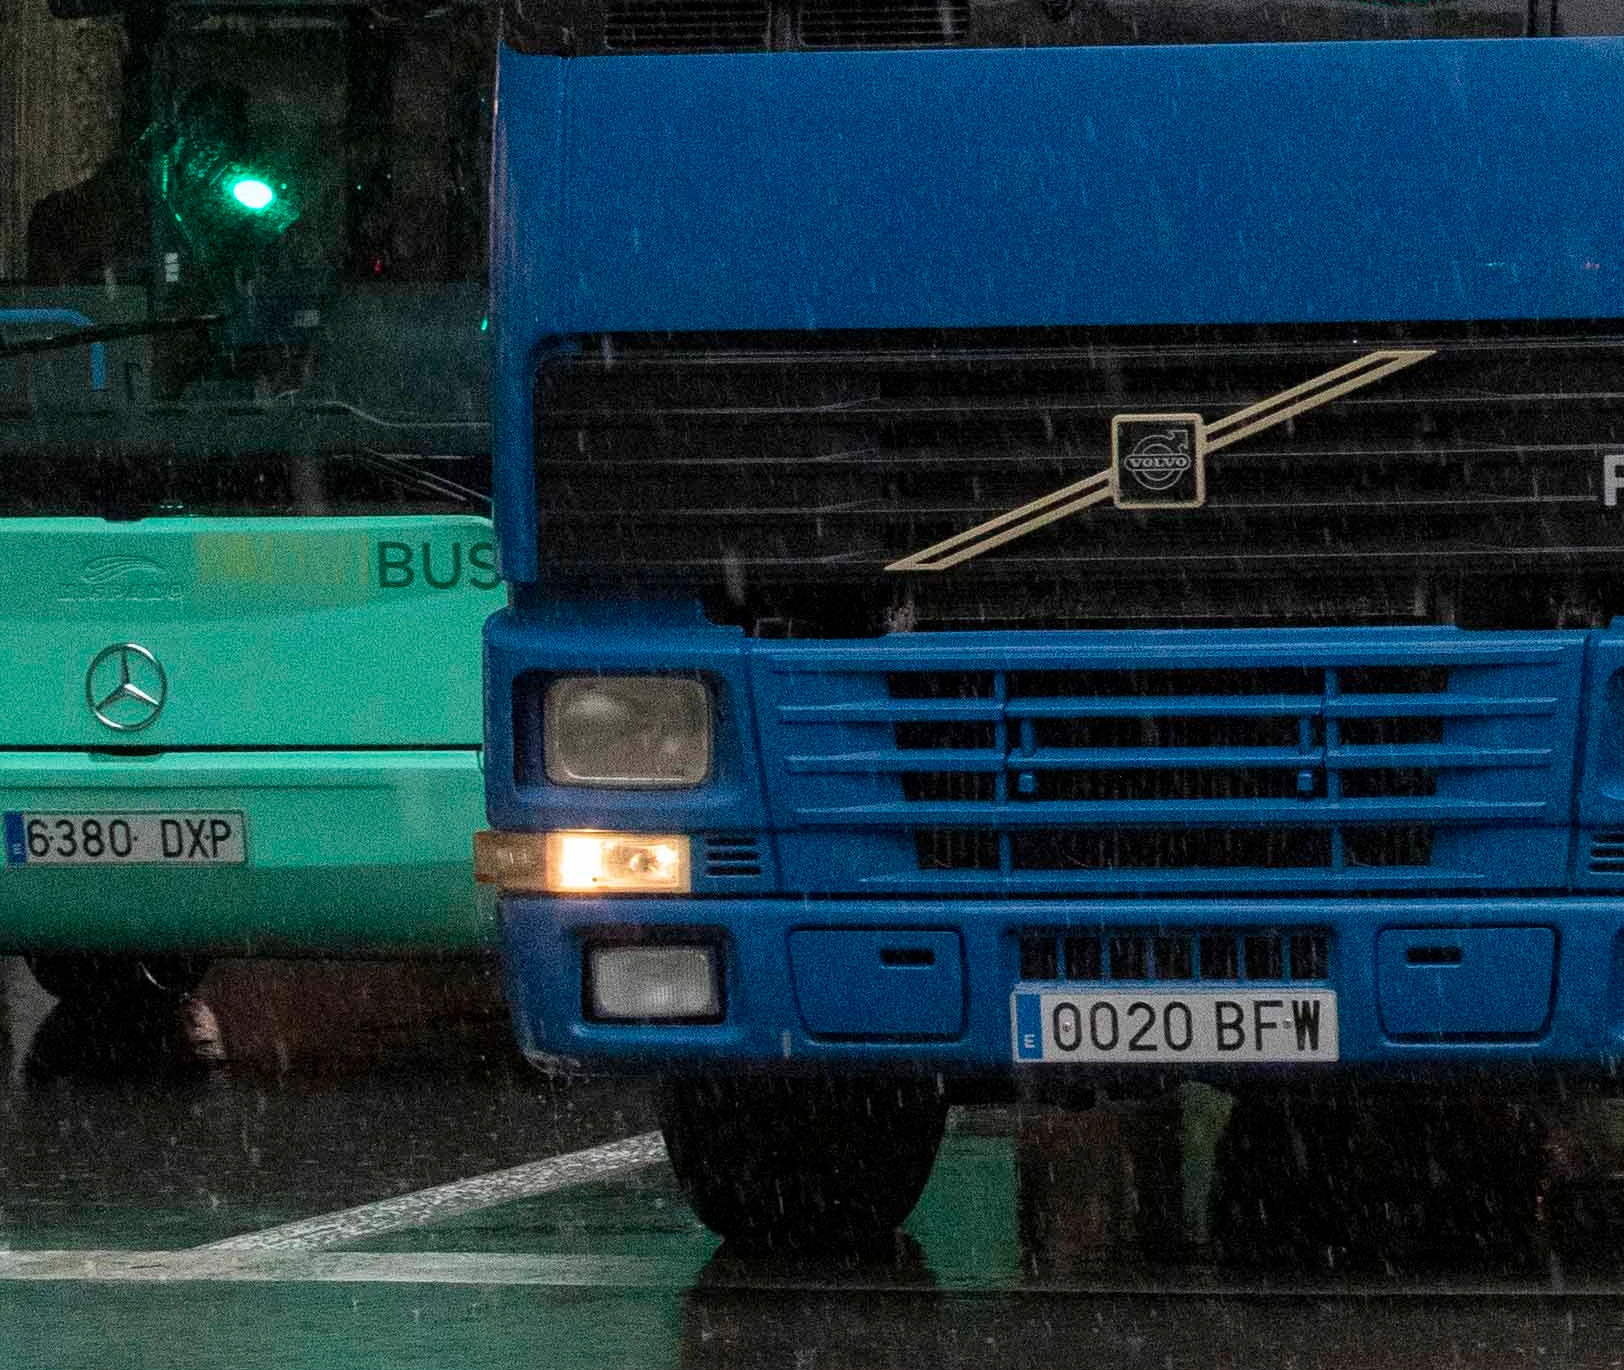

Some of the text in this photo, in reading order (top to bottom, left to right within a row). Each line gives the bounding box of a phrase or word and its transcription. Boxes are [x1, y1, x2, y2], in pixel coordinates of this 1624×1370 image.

[1127, 456, 1188, 469] VOLVO
[377, 540, 501, 590] BUS
[26, 818, 232, 859] 6380 DXP
[1052, 999, 1322, 1053] 0020 BFW
